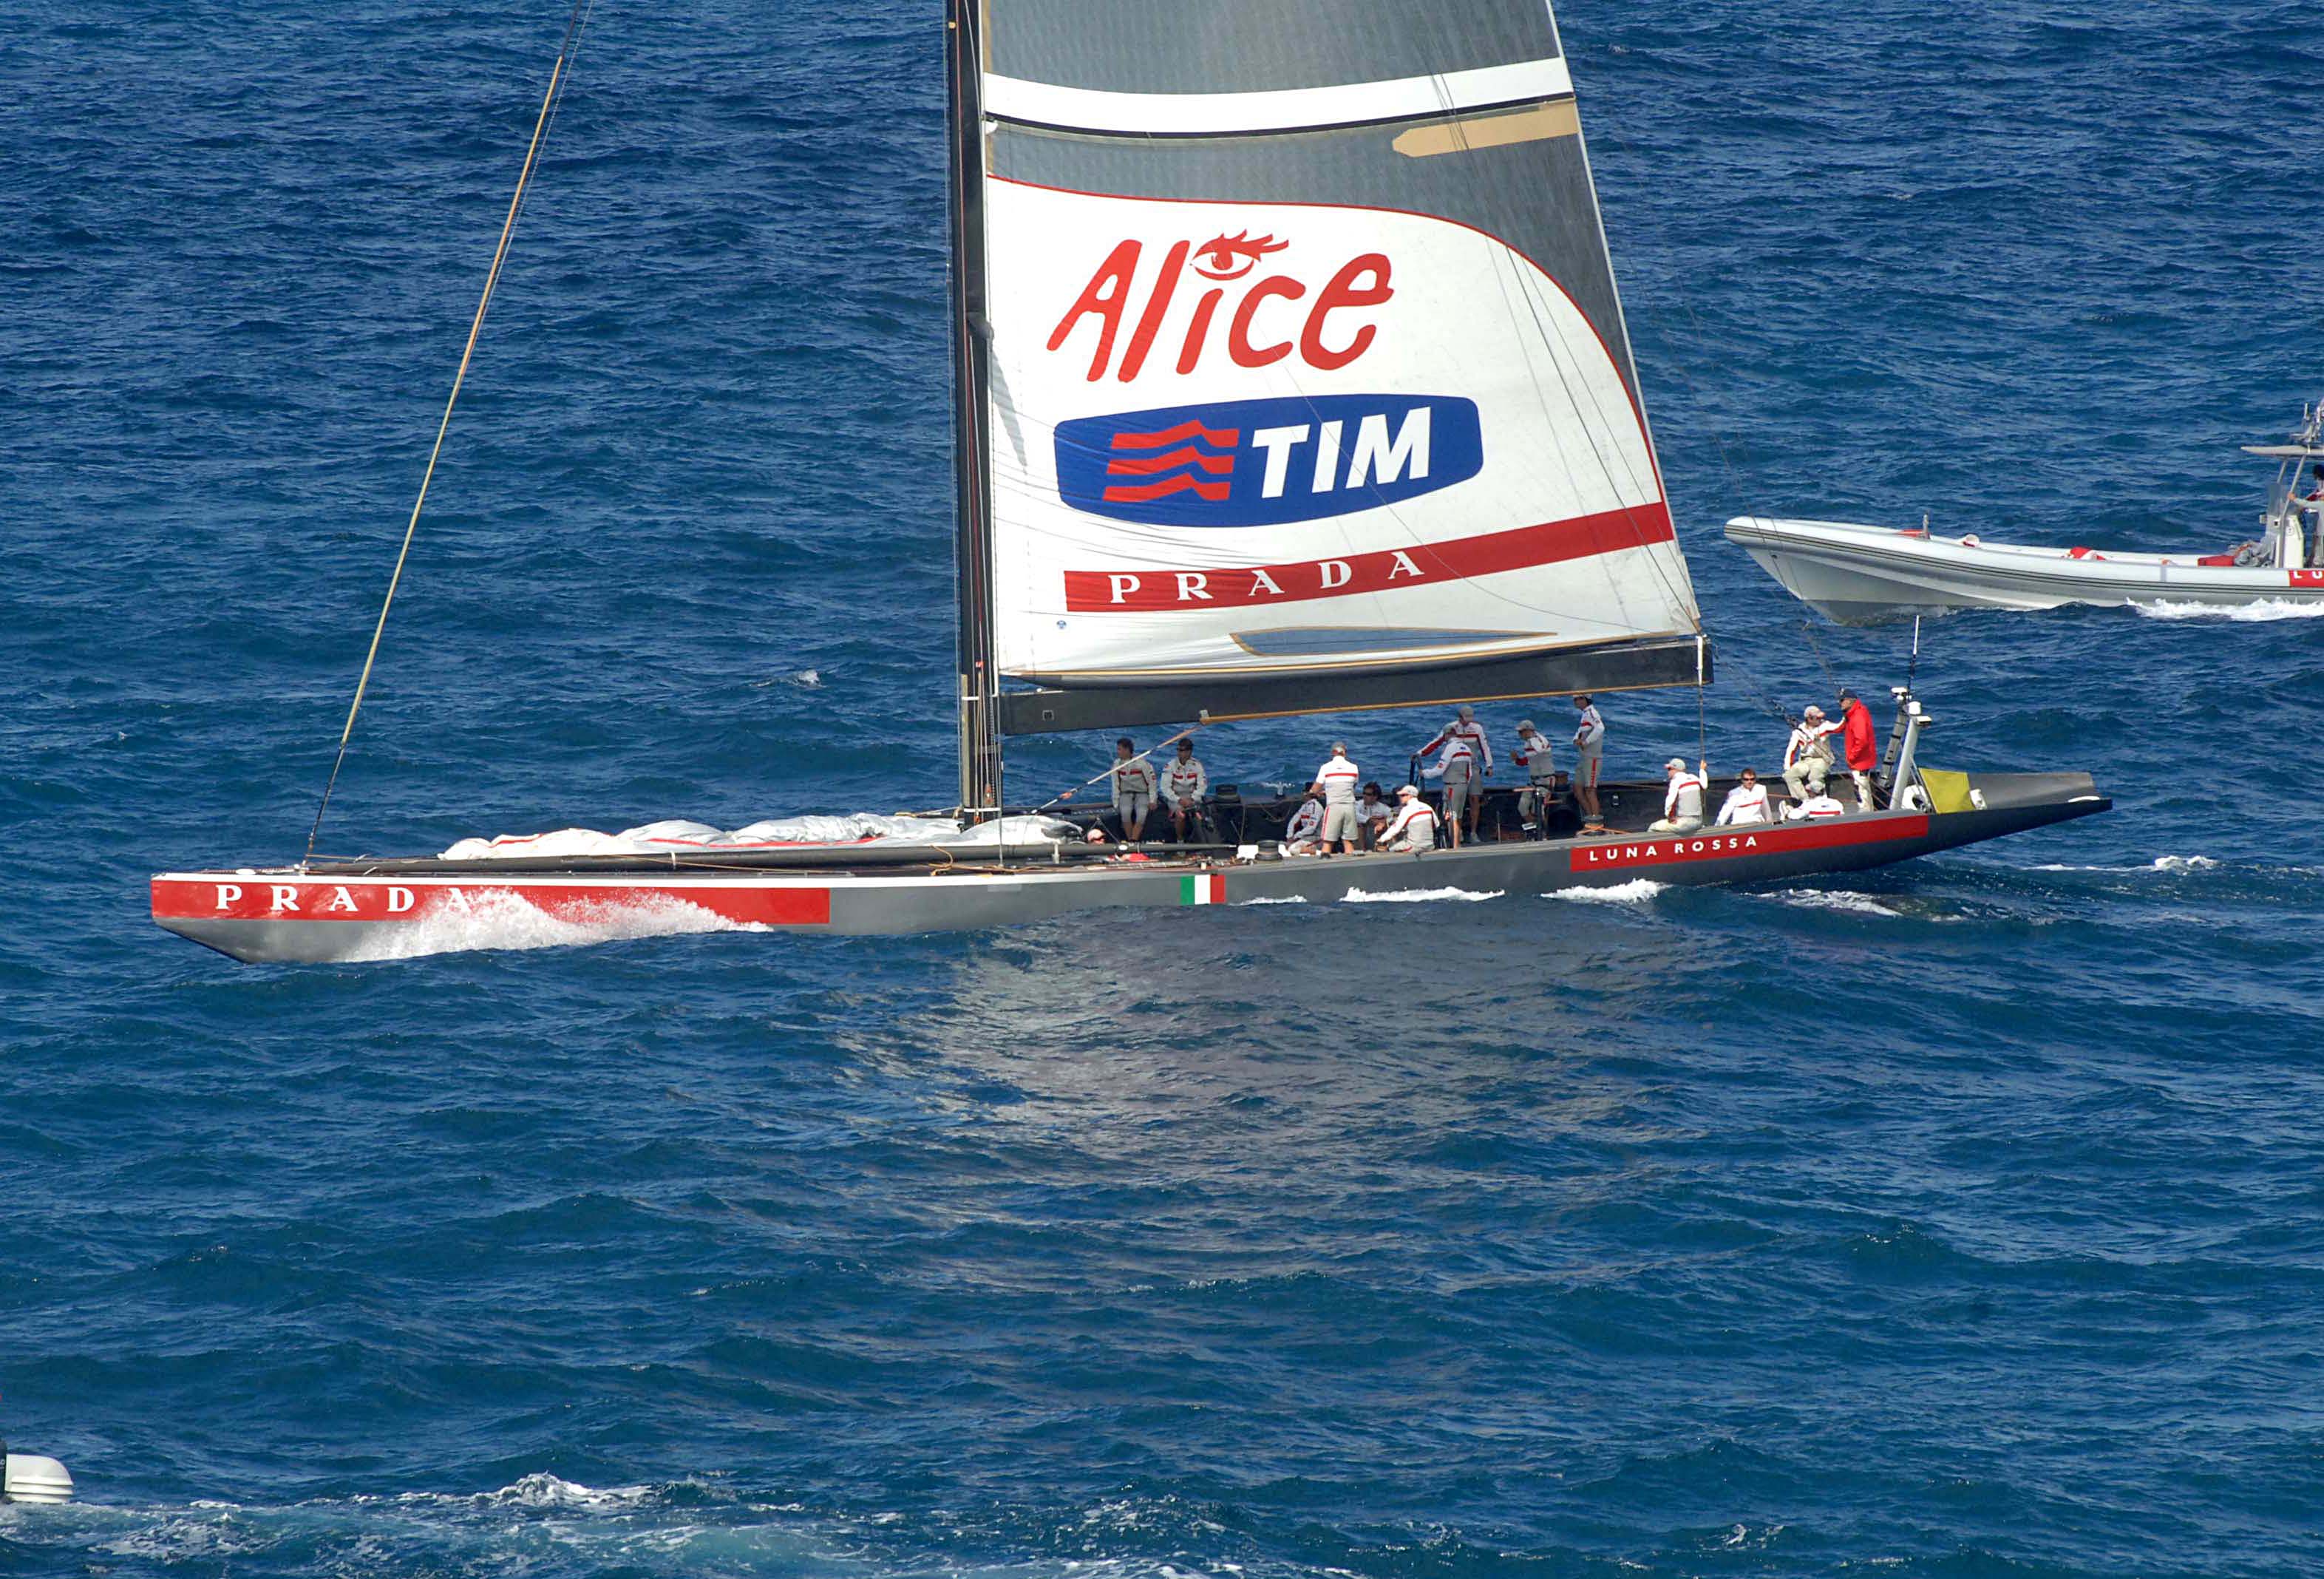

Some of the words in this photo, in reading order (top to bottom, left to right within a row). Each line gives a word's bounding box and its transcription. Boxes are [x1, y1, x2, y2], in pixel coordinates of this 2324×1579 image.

[1046, 239, 1394, 383] Alice
[1251, 407, 1431, 499] TIM
[1108, 551, 1424, 604] PRADA
[1589, 845, 1657, 862] LUNA
[1674, 836, 1757, 854] ROSSA
[215, 884, 472, 912] PRADA
